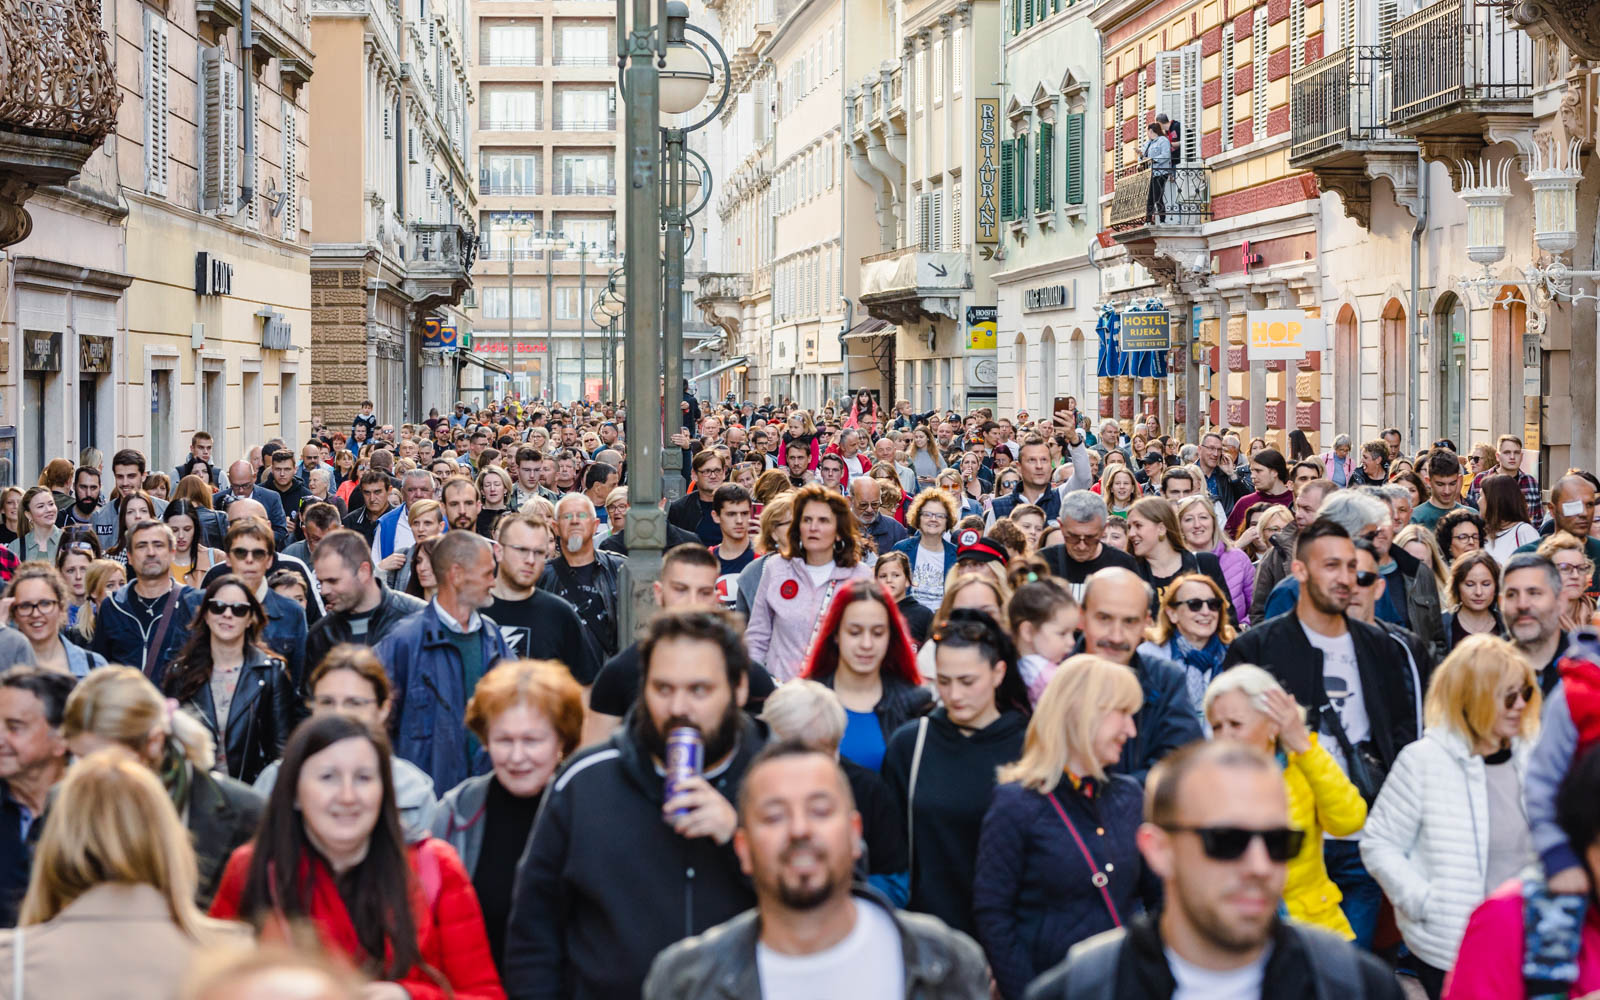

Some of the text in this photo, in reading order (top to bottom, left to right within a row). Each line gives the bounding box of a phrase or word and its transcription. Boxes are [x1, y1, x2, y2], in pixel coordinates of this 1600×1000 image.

[979, 103, 996, 238] RESTAURANT
[1123, 315, 1167, 326] HOSTEL
[1130, 328, 1161, 336] RIJEKA
[1252, 321, 1303, 342] HOP
[474, 342, 547, 353] Addik Bank
